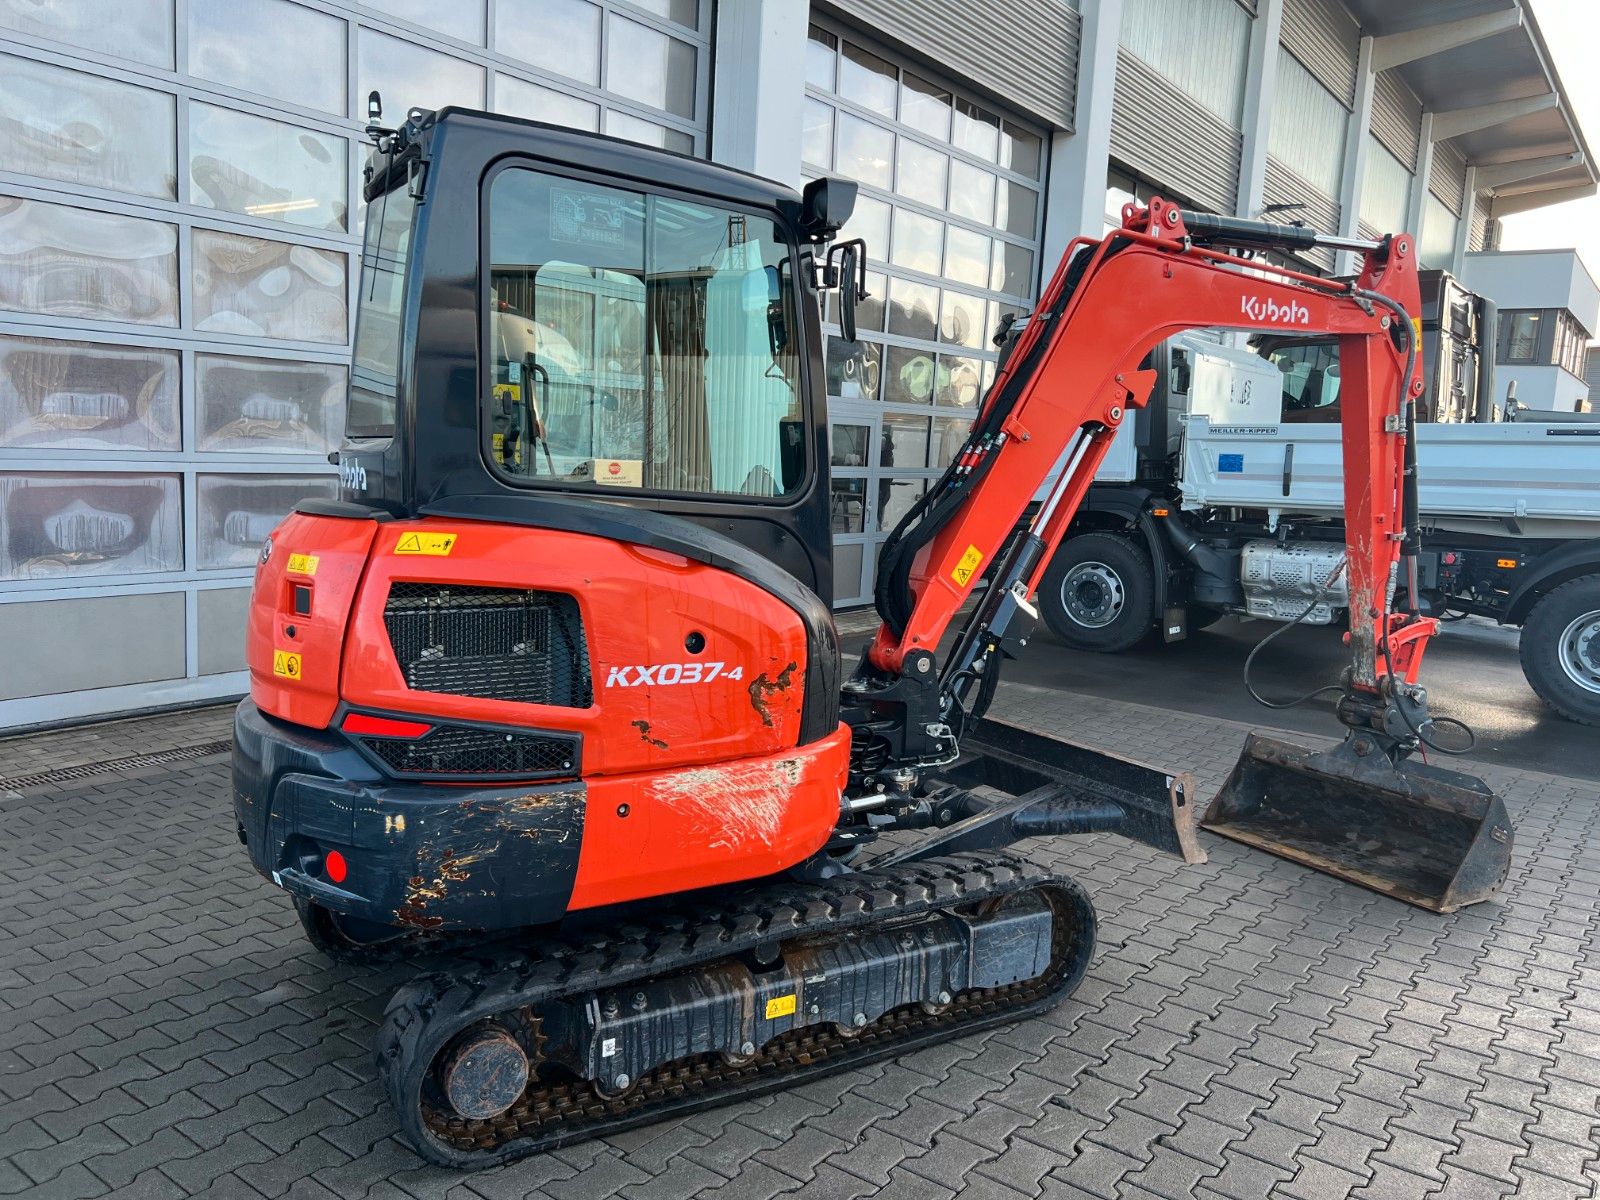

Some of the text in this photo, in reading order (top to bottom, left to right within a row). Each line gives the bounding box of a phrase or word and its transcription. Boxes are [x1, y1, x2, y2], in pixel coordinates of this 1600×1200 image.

[1240, 295, 1309, 324] Kubota
[340, 457, 367, 491] ubota
[605, 661, 744, 688] KX037-4
